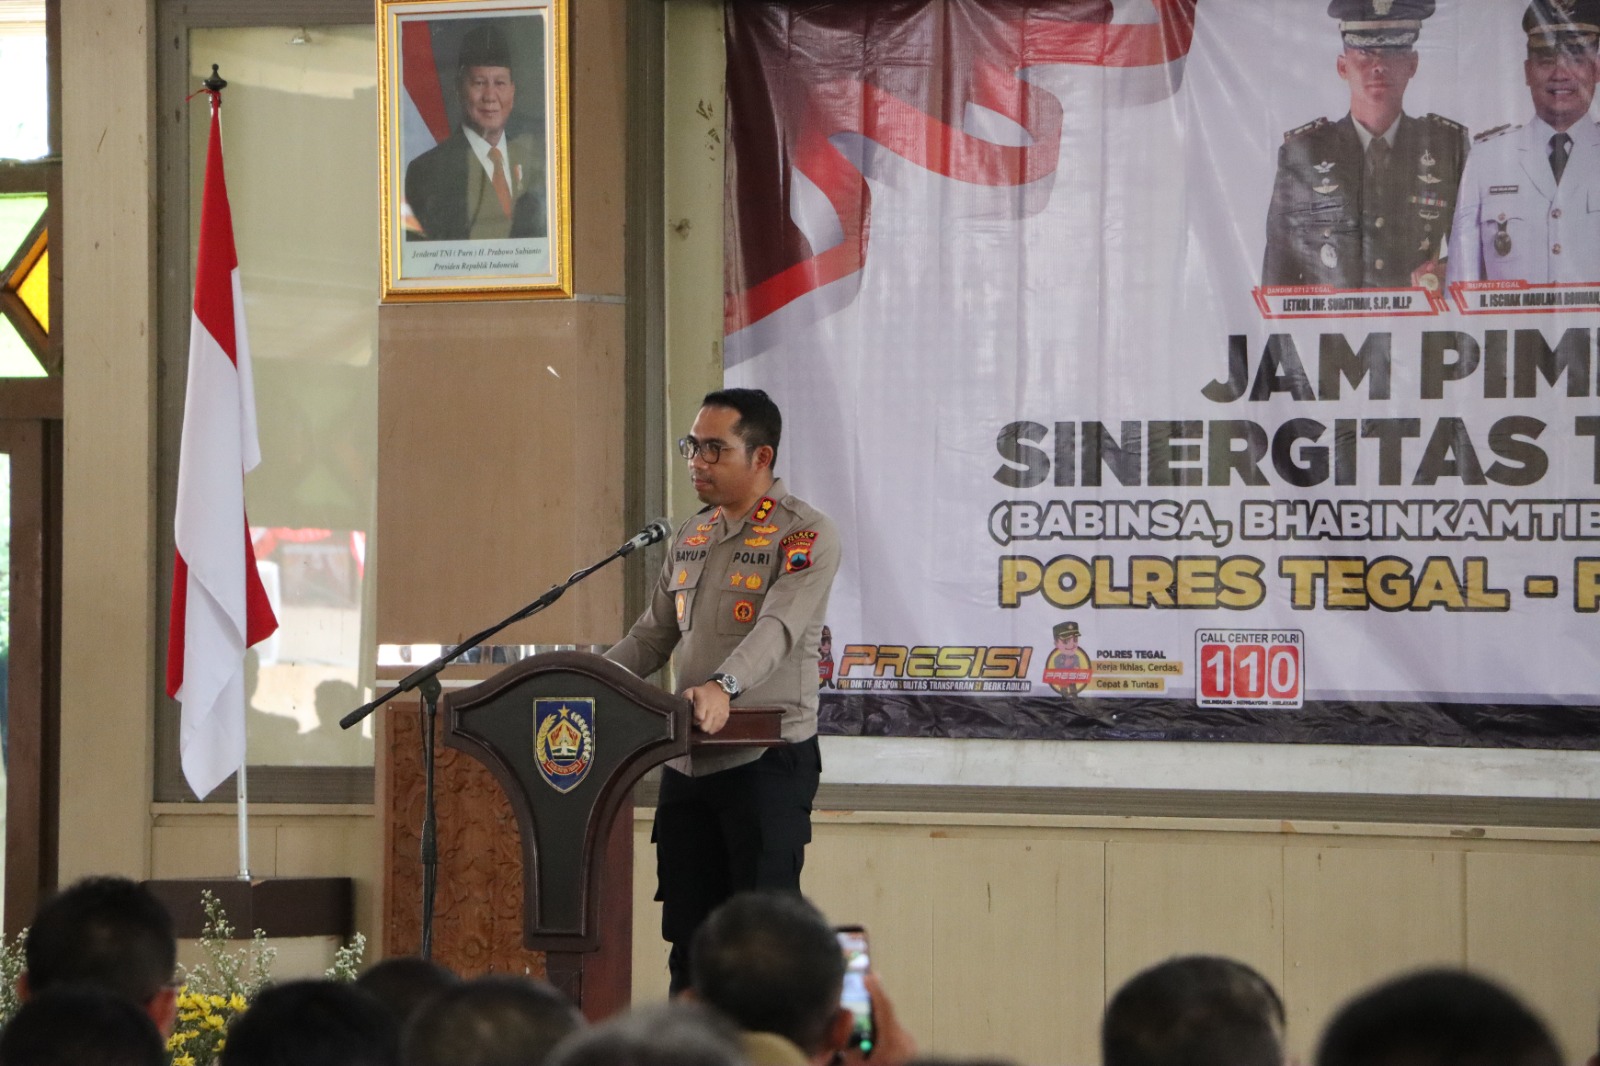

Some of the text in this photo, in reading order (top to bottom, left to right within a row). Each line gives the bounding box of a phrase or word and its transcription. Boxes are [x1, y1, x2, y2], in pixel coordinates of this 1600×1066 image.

[440, 250, 452, 258] TNI
[487, 248, 514, 256] Prabowo
[515, 247, 541, 255] Subianto
[434, 260, 519, 270] Presiden Republik Indonesia
[1467, 281, 1520, 289] BUPATI TEGAL
[1201, 328, 1600, 402] JAM PIM
[992, 414, 1549, 488] SINERGITAS
[987, 499, 1232, 547] (BABINSA,
[675, 550, 697, 562] BAYU
[732, 551, 770, 565] POLRI
[998, 554, 1267, 612] POLRES
[1278, 555, 1511, 613] TEGAL
[1201, 632, 1299, 644] CALL CENTER POLRI
[838, 644, 1033, 678] PRESISI
[1096, 650, 1166, 660] POLRES TEGAL
[1096, 661, 1180, 674] Kerja Ikhlas, Cerdas,
[1206, 650, 1296, 693] 110
[1045, 671, 1090, 680] PRESISI
[1096, 679, 1159, 691] Cepat & Tuntas
